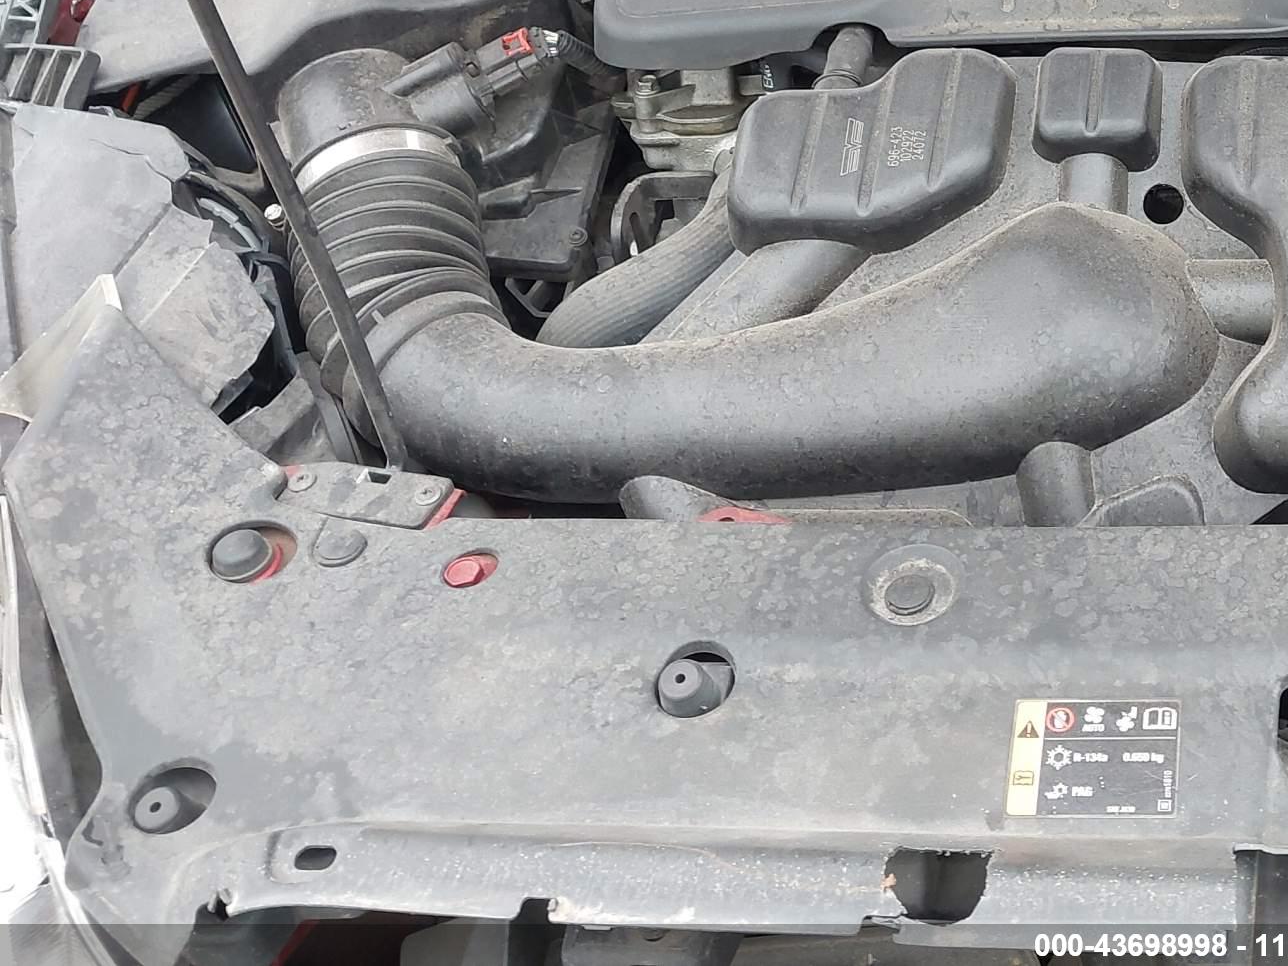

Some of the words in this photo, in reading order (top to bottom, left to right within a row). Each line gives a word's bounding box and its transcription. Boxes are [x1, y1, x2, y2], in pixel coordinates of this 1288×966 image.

[887, 126, 903, 167] 696-423
[899, 129, 915, 162] 102922
[911, 130, 927, 160] 24072
